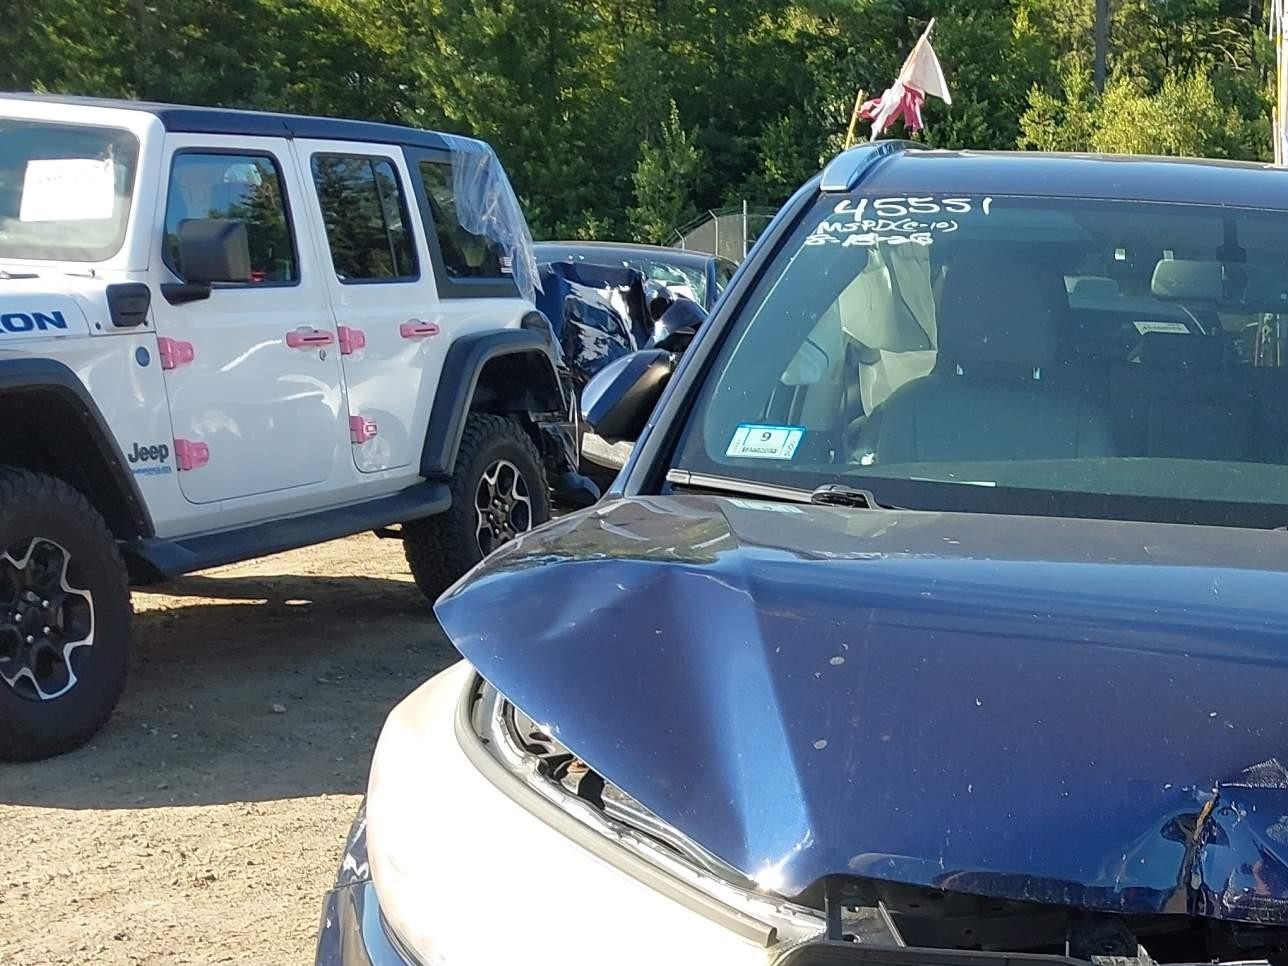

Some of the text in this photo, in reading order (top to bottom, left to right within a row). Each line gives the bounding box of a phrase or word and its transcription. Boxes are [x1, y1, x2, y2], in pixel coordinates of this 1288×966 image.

[833, 196, 993, 222] 45551
[0, 311, 69, 334] ON
[127, 442, 169, 463] Jeep
